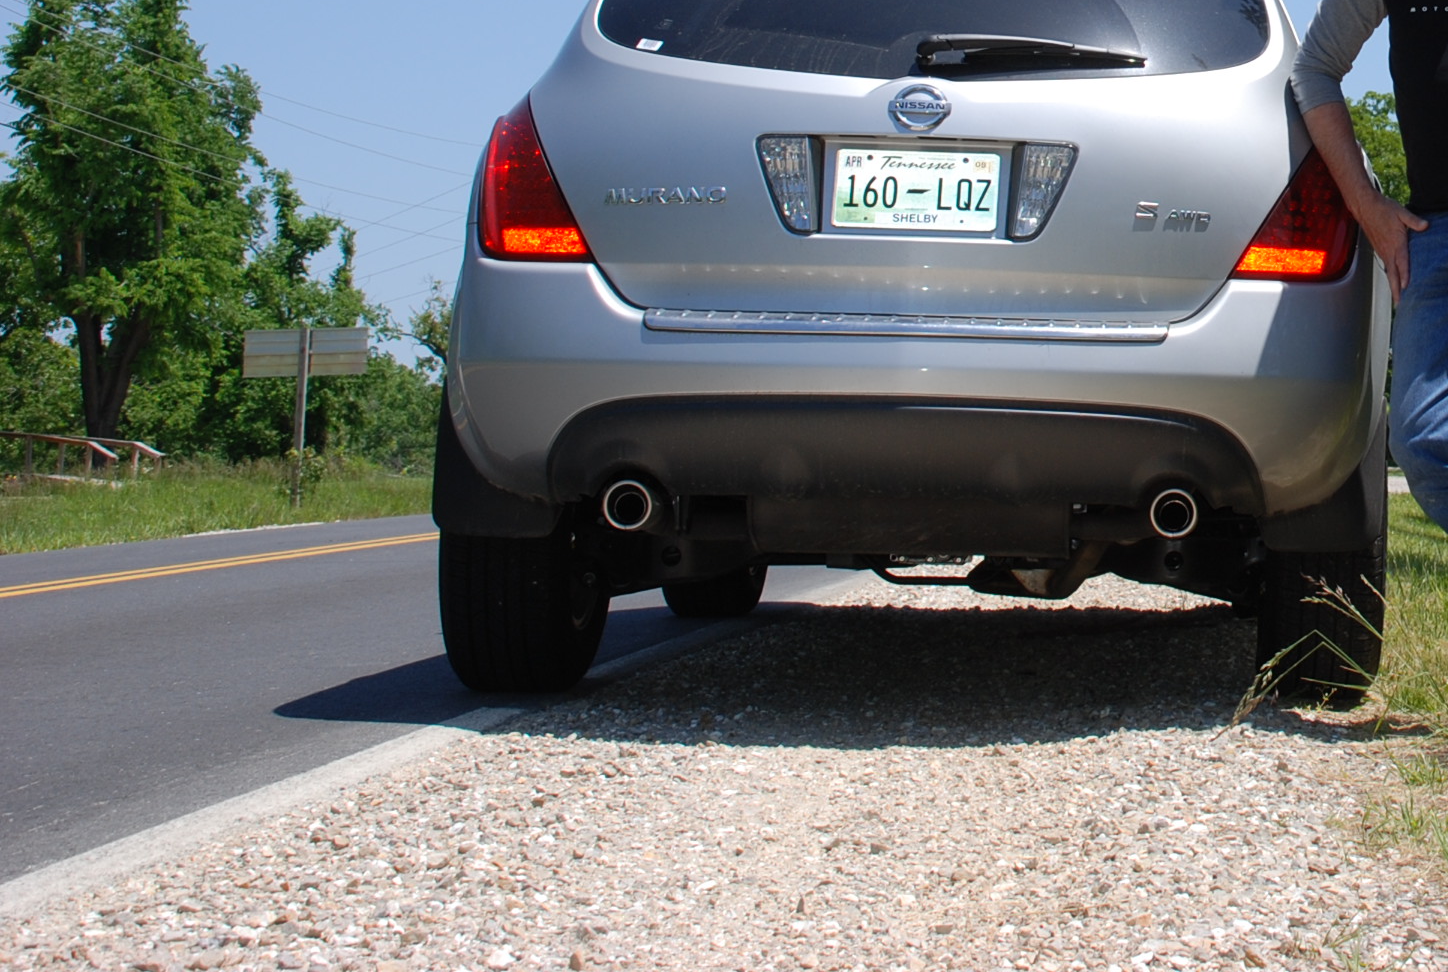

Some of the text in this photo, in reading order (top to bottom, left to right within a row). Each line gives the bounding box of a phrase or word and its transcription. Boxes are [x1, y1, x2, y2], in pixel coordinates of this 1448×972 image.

[895, 101, 945, 110] NISSAN
[845, 156, 862, 167] APR
[880, 155, 957, 170] Tennessee
[605, 187, 727, 205] MURANO
[892, 213, 938, 223] SHELBY
